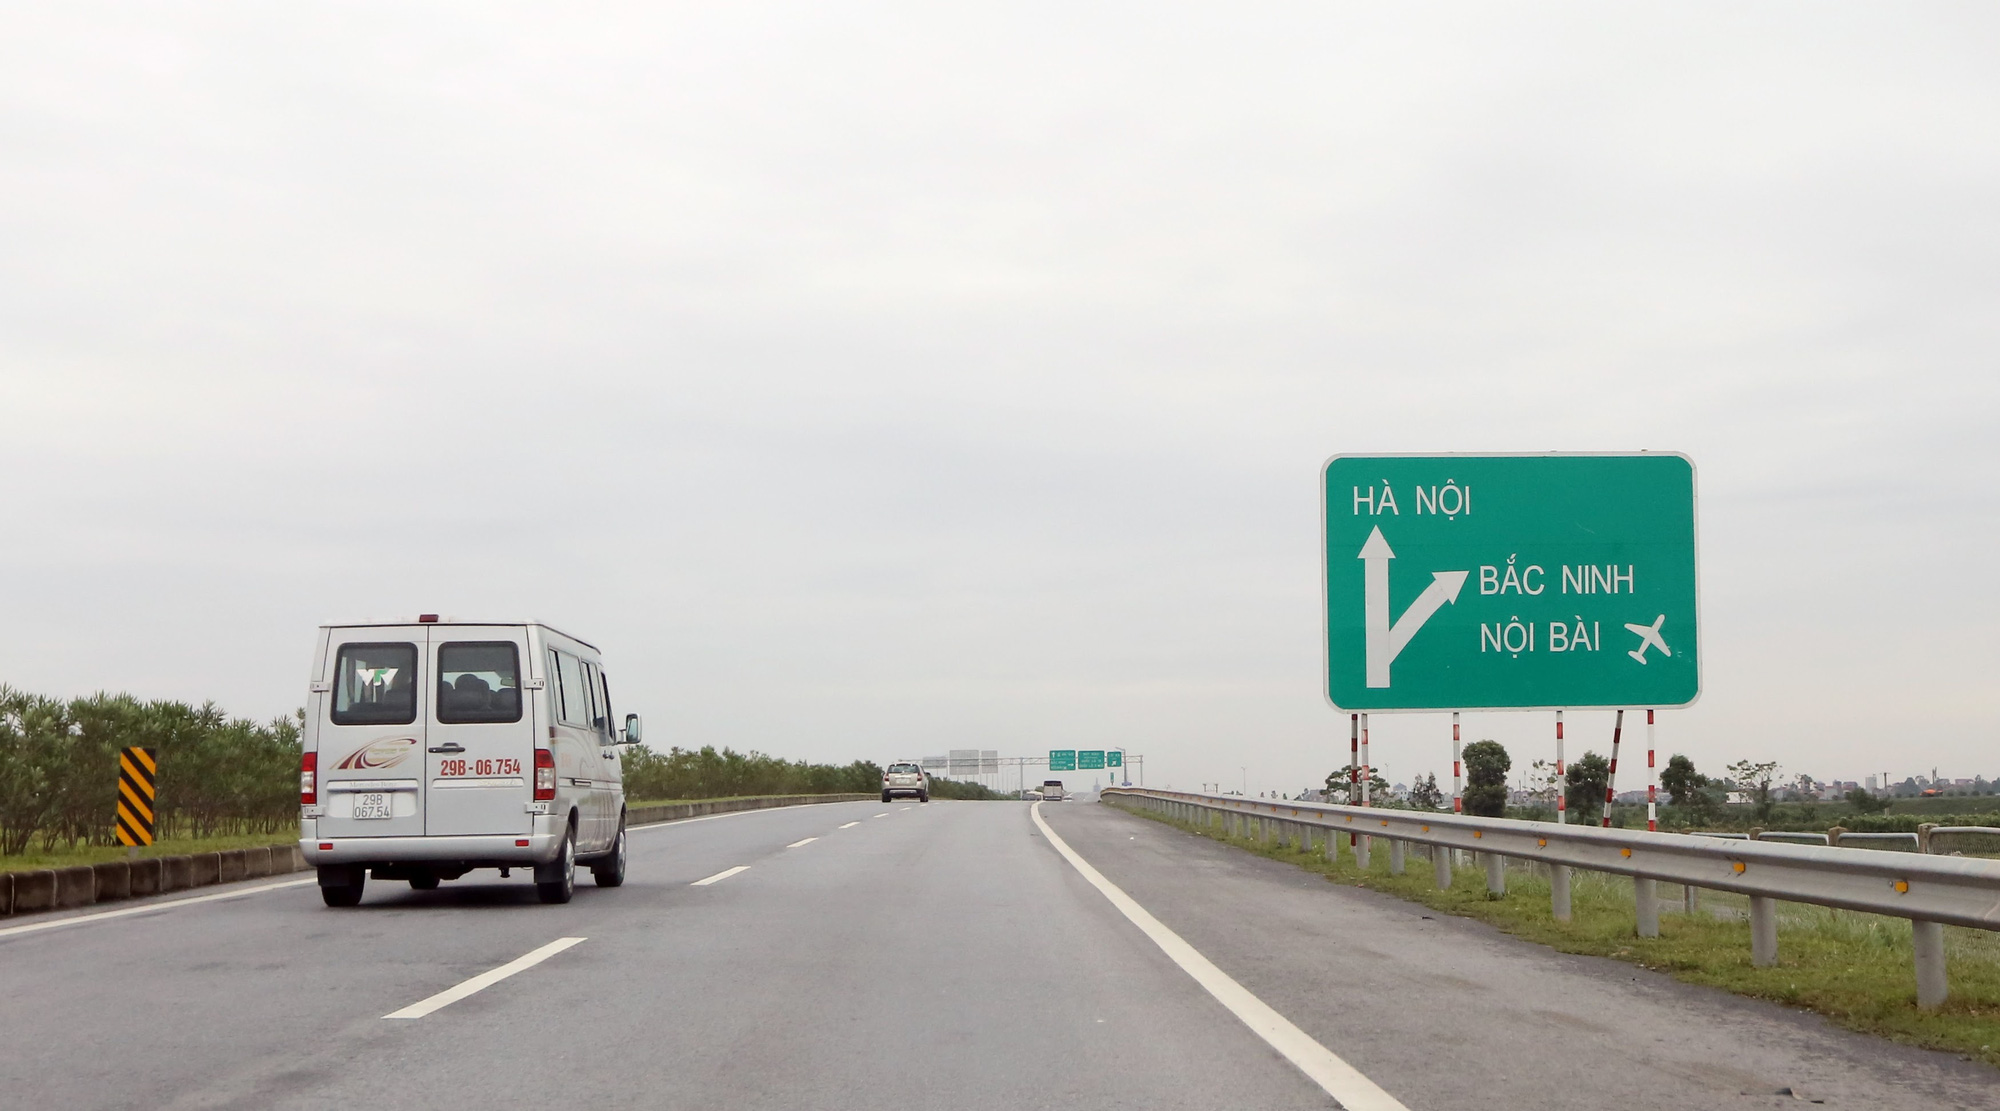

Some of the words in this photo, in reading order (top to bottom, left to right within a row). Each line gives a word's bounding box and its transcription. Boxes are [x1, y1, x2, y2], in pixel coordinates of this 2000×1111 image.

[1353, 479, 1399, 515] HÀ
[1417, 479, 1470, 520] NỘI
[1480, 553, 1545, 595] BẮC
[1562, 565, 1634, 594] NINH
[1481, 616, 1534, 658] NỘI
[1549, 615, 1600, 651] BÀI
[354, 806, 390, 818] 067.54
[363, 794, 383, 806] 29B
